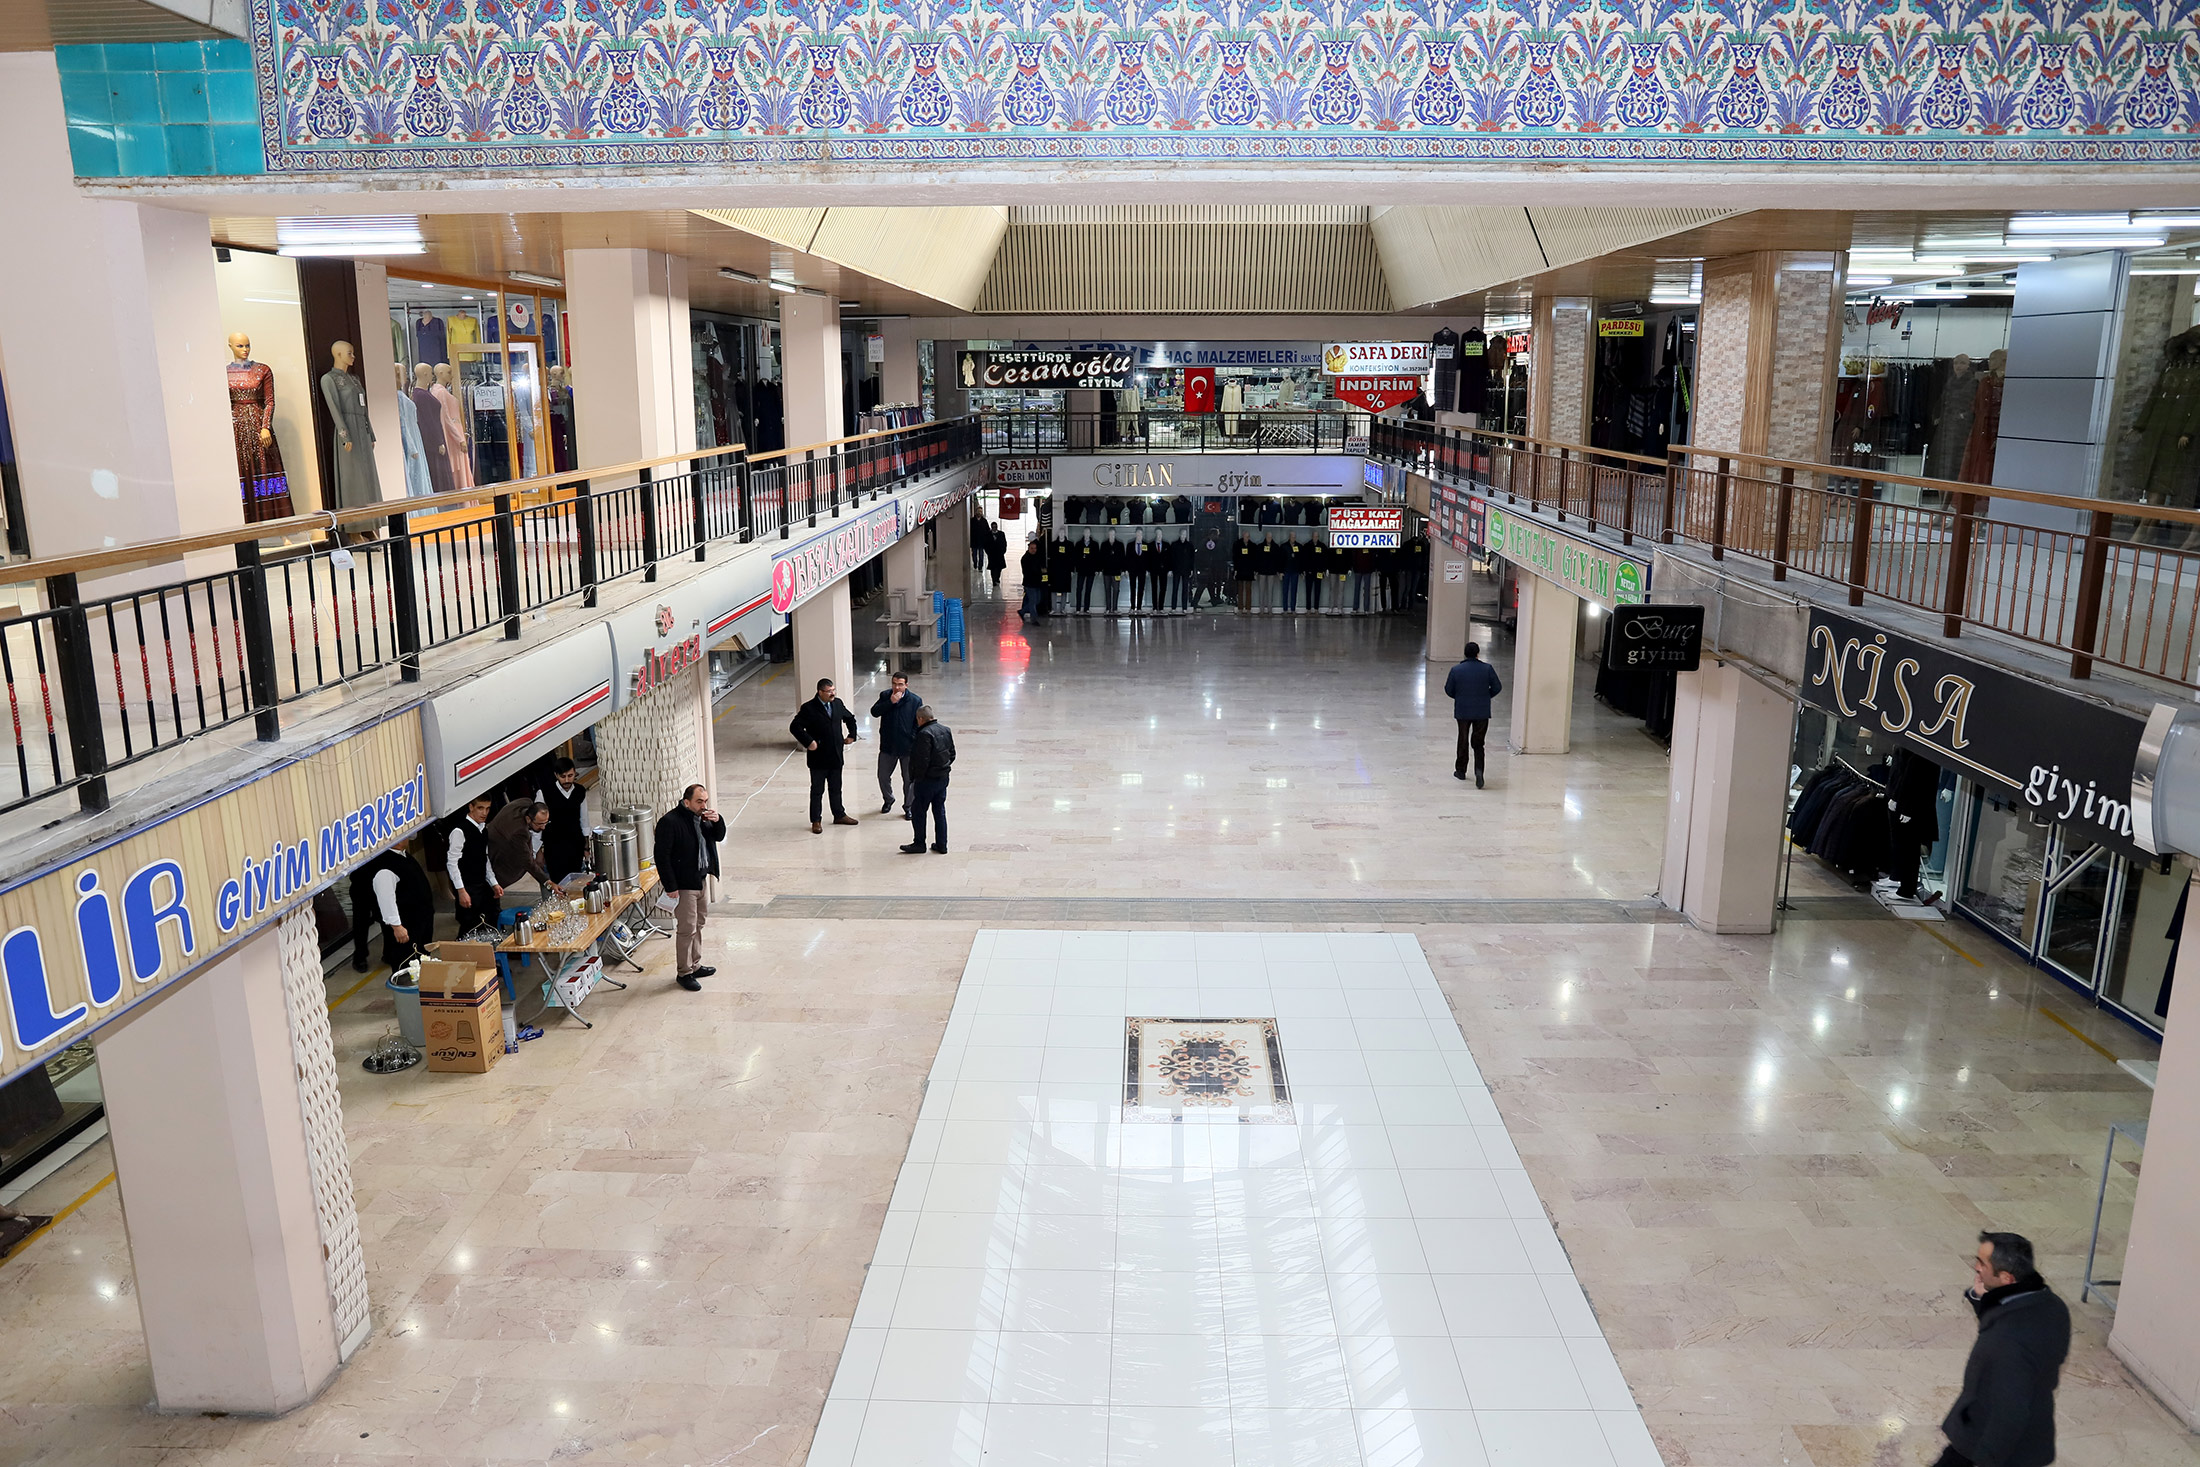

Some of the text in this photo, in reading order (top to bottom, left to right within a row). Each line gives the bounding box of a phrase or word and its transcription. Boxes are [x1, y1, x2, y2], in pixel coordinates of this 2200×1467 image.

[1600, 320, 1641, 332] PARDESÜ
[1166, 350, 1192, 363] HAC
[1349, 346, 1389, 360] SAFA
[1390, 344, 1428, 360] DERİ
[1349, 363, 1400, 372] KONFEKSİYON
[1340, 377, 1414, 391] İNDİRİM
[1366, 393, 1386, 408] %
[998, 458, 1049, 472] ŞAHİN
[1028, 471, 1050, 481] MONT
[1217, 471, 1263, 493] giyim
[1343, 509, 1391, 519] ÜST KAT
[1330, 518, 1400, 530] MAĞAZALARI
[1337, 534, 1394, 546] OTO PARK
[1508, 521, 1557, 573] NEVZAT
[793, 518, 873, 601] BEYAZGÜL
[1624, 614, 1696, 646] Burç
[1627, 646, 1687, 665] giyim
[634, 633, 700, 697] alvera
[1811, 625, 2133, 837] NİSA giyim
[215, 838, 312, 934] GİYİM
[317, 762, 426, 876] MERKEZİ
